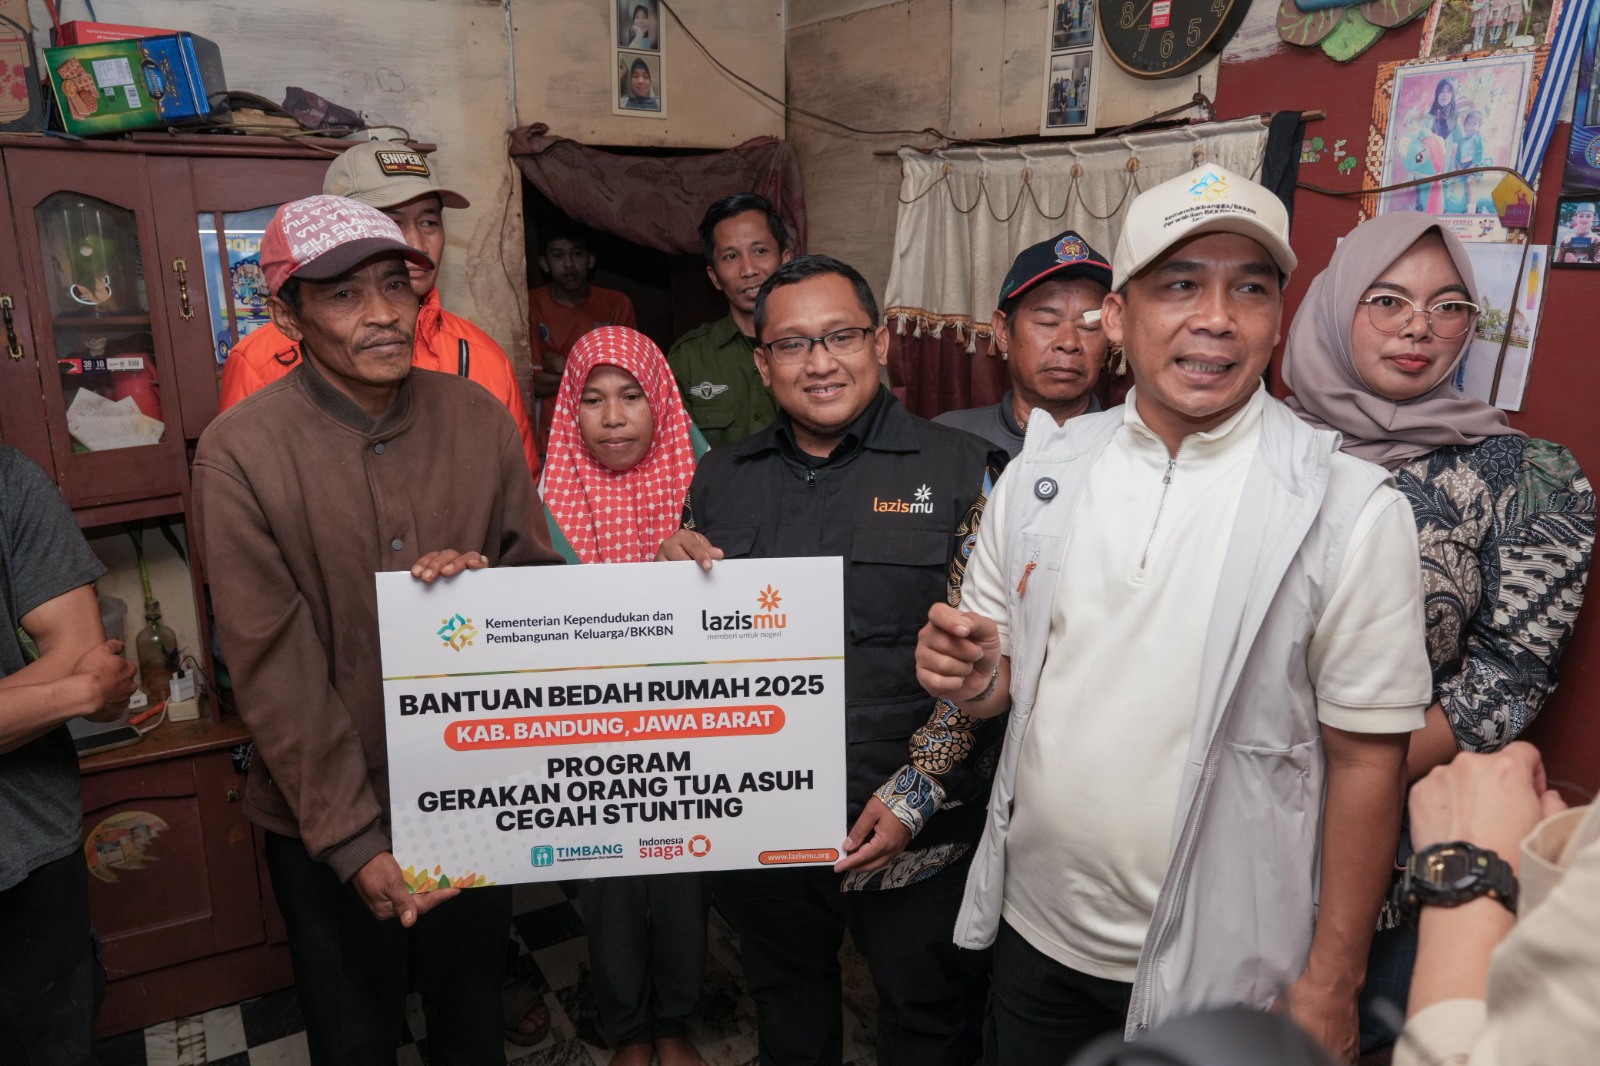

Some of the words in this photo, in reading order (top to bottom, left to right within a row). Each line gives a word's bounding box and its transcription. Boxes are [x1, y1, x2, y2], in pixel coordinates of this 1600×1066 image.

[1120, 1, 1135, 29] 8
[1138, 24, 1151, 52] 7
[1186, 18, 1202, 47] 5
[1160, 31, 1175, 59] 6
[381, 153, 423, 165] SNIPER
[310, 202, 341, 216] FILA
[296, 218, 327, 239] FILA
[330, 217, 362, 234] FILA
[336, 224, 368, 241] FILA
[300, 233, 331, 253] FILA
[83, 360, 92, 368] 38
[96, 360, 105, 368] 10
[873, 497, 934, 514] lazismu
[485, 615, 560, 629] Kementerian
[563, 612, 650, 627] Kependudukan
[652, 611, 674, 621] dan
[702, 609, 787, 631] lazismu
[486, 631, 569, 644] Pembangunan
[574, 625, 674, 640] Keluarga/BKKBN
[707, 632, 738, 640] memberi
[739, 631, 759, 639] untuk
[760, 630, 782, 639] negeri
[399, 686, 543, 716] BANTUAN
[548, 682, 643, 707] BEDAH
[648, 677, 750, 702] RUMAH
[754, 674, 825, 697] 2025
[456, 723, 511, 743] KAB.
[513, 717, 630, 740] BANDUNG,
[632, 713, 698, 733] JAWA
[702, 710, 775, 730] BARAT
[547, 751, 691, 779] PROGRAM
[417, 782, 561, 812] GERAKAN
[566, 777, 668, 802] ORANG
[673, 773, 732, 796] TUA
[738, 769, 814, 793] ASUH
[495, 804, 597, 831] CEGAH
[602, 797, 743, 824] STUNTING
[556, 843, 623, 858] TIMBANG
[639, 837, 684, 846] Indonesia
[639, 845, 684, 860] siaga
[767, 852, 830, 861] www.lazismu.org
